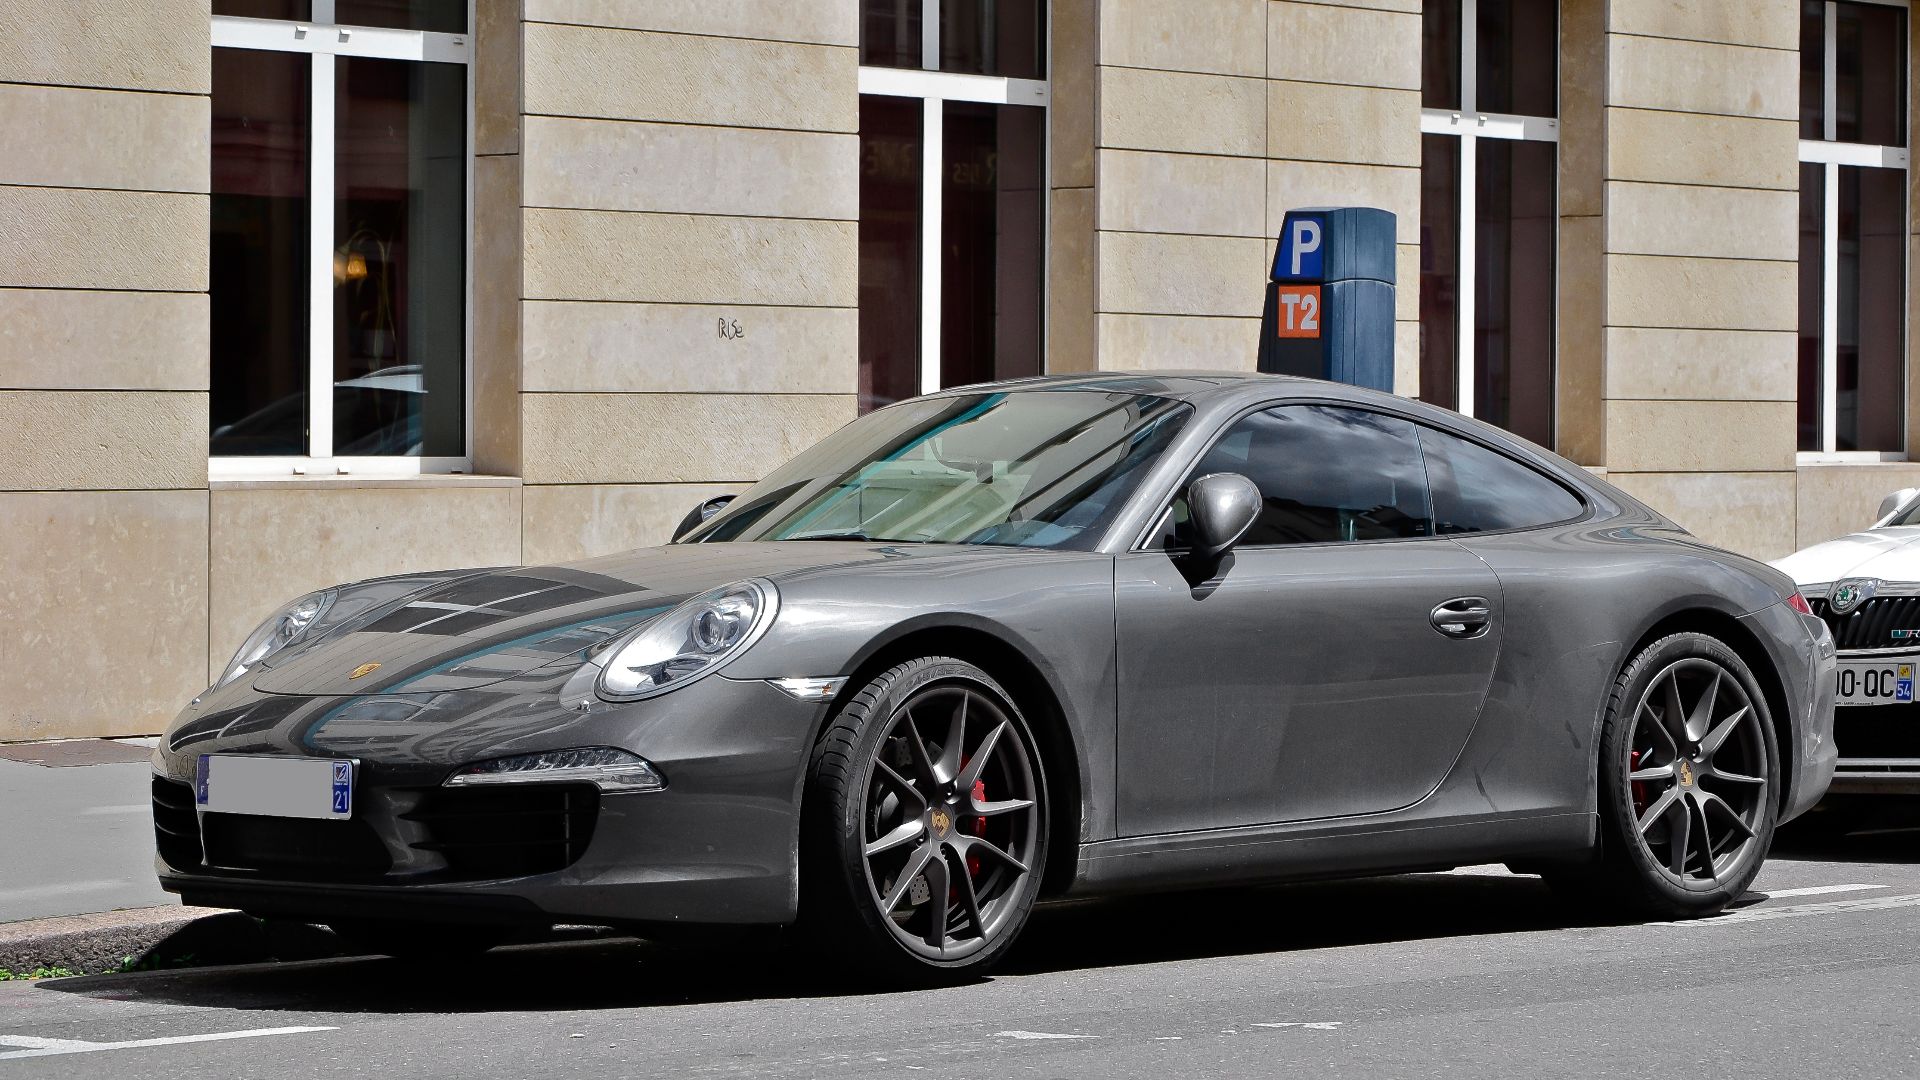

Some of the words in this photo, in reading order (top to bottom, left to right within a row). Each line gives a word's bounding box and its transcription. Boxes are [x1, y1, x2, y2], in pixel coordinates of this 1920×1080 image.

[1291, 220, 1322, 275] P
[1281, 293, 1318, 331] T2
[1897, 683, 1911, 697] 54
[200, 785, 205, 796] F
[334, 790, 348, 810] 21
